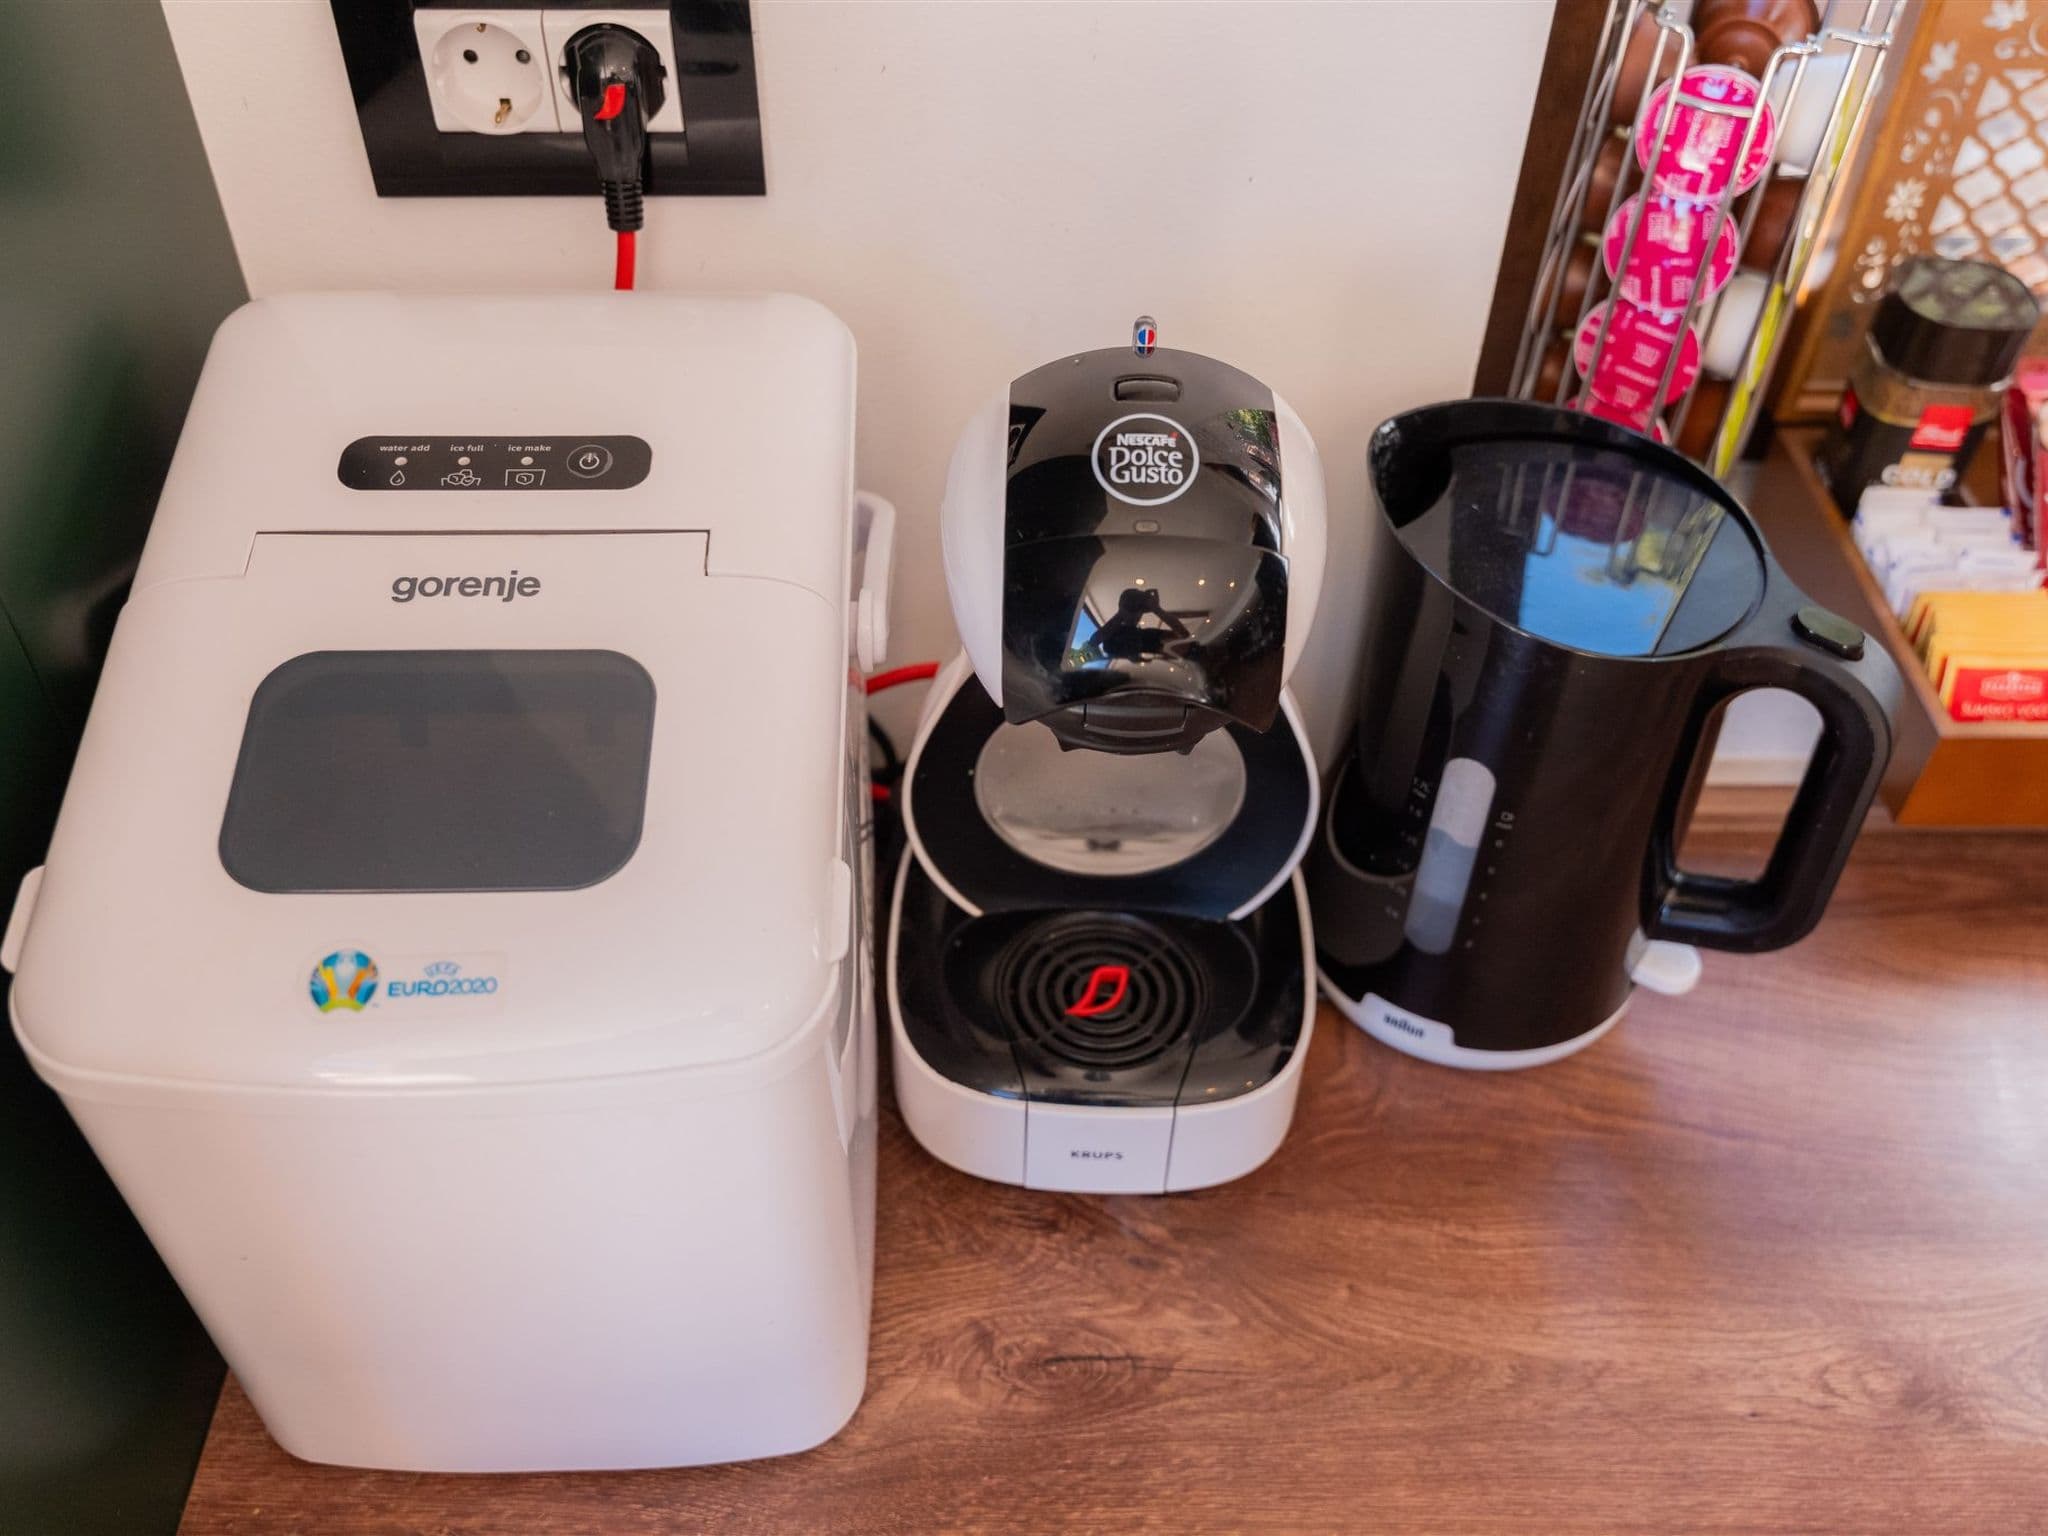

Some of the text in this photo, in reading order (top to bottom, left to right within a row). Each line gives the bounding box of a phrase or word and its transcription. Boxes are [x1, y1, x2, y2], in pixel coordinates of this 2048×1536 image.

[379, 444, 431, 452] water add
[450, 444, 484, 452] ice full
[508, 444, 552, 452] ice make
[1109, 447, 1184, 468] Dolce
[1110, 466, 1184, 485] Gusto
[391, 570, 541, 603] gorenje
[388, 977, 498, 997] EURO2020
[1070, 1149, 1124, 1160] KRUPS
